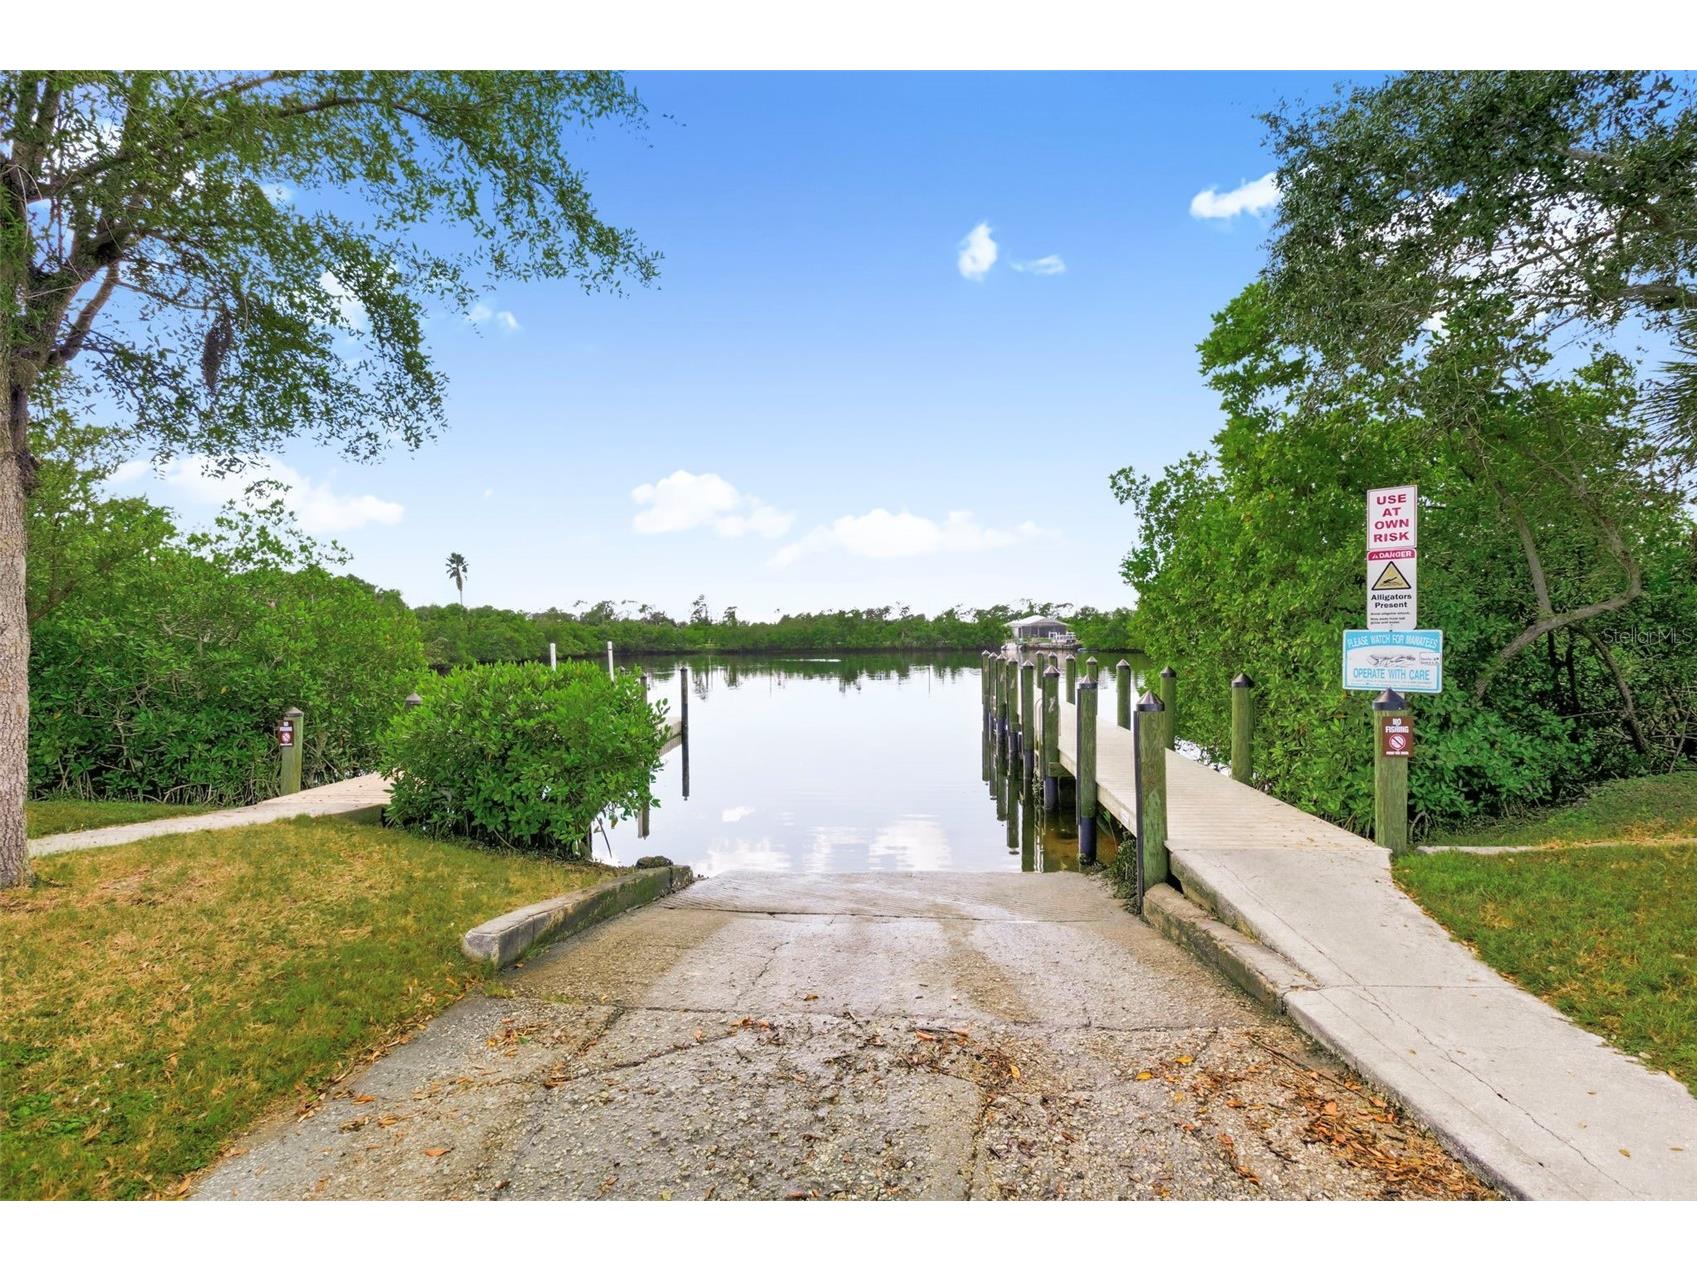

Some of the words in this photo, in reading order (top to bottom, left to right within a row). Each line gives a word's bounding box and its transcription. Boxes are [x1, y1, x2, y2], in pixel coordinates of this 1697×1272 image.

[1376, 494, 1406, 505] USE
[1382, 507, 1401, 517] AT
[1374, 519, 1409, 530] OWN
[1373, 532, 1409, 543] RISK
[1380, 551, 1412, 559] DANGER
[1371, 593, 1412, 601] Alligators
[1348, 635, 1369, 648] PLEASE
[1370, 634, 1391, 644] WATCH
[1392, 634, 1405, 644] FOR
[1353, 668, 1385, 678] OPERATE
[1388, 669, 1406, 679] WITH
[1409, 670, 1430, 680] CARE
